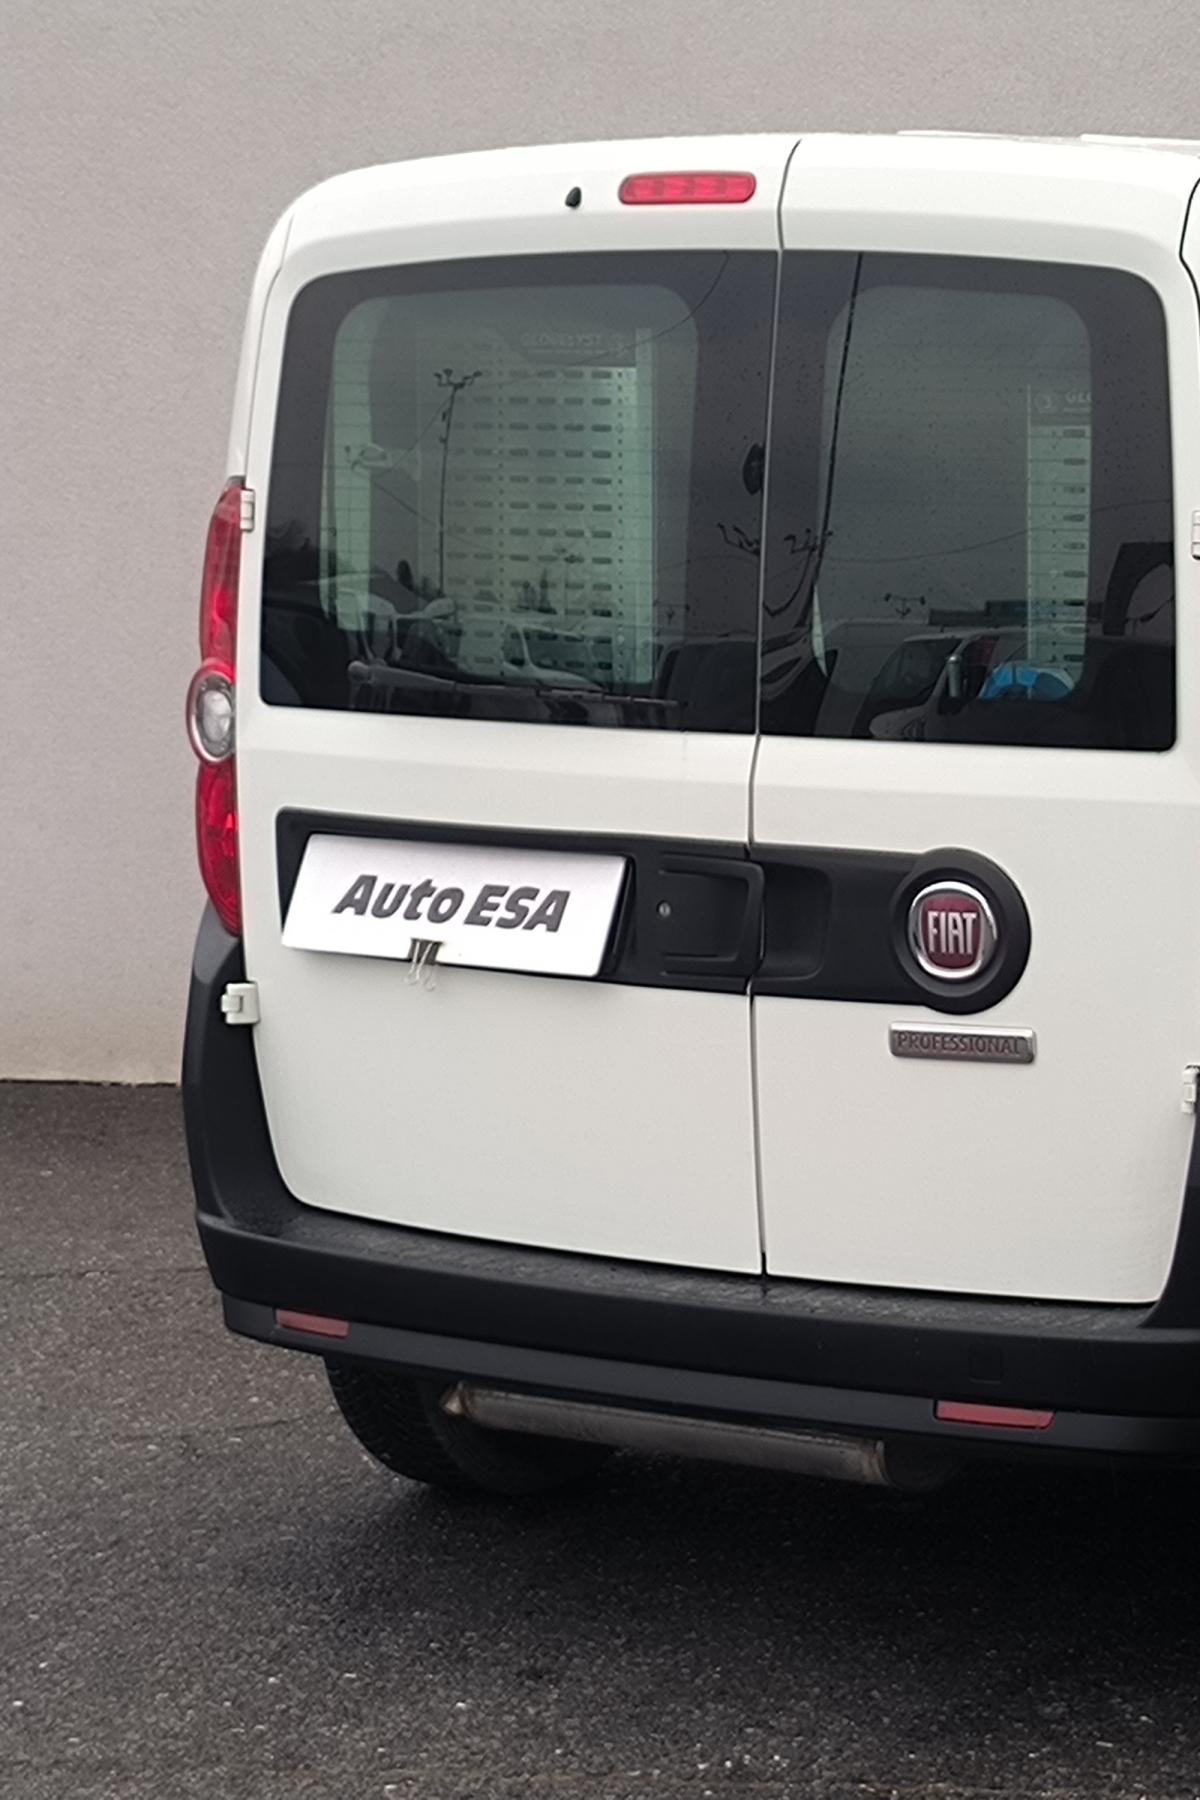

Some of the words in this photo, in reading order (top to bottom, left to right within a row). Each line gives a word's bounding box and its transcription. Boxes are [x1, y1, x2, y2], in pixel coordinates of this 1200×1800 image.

[332, 874, 464, 923] Auto
[463, 884, 571, 933] ESA
[927, 911, 978, 954] FIAT
[897, 1033, 1021, 1055] PROFESSIONAL
